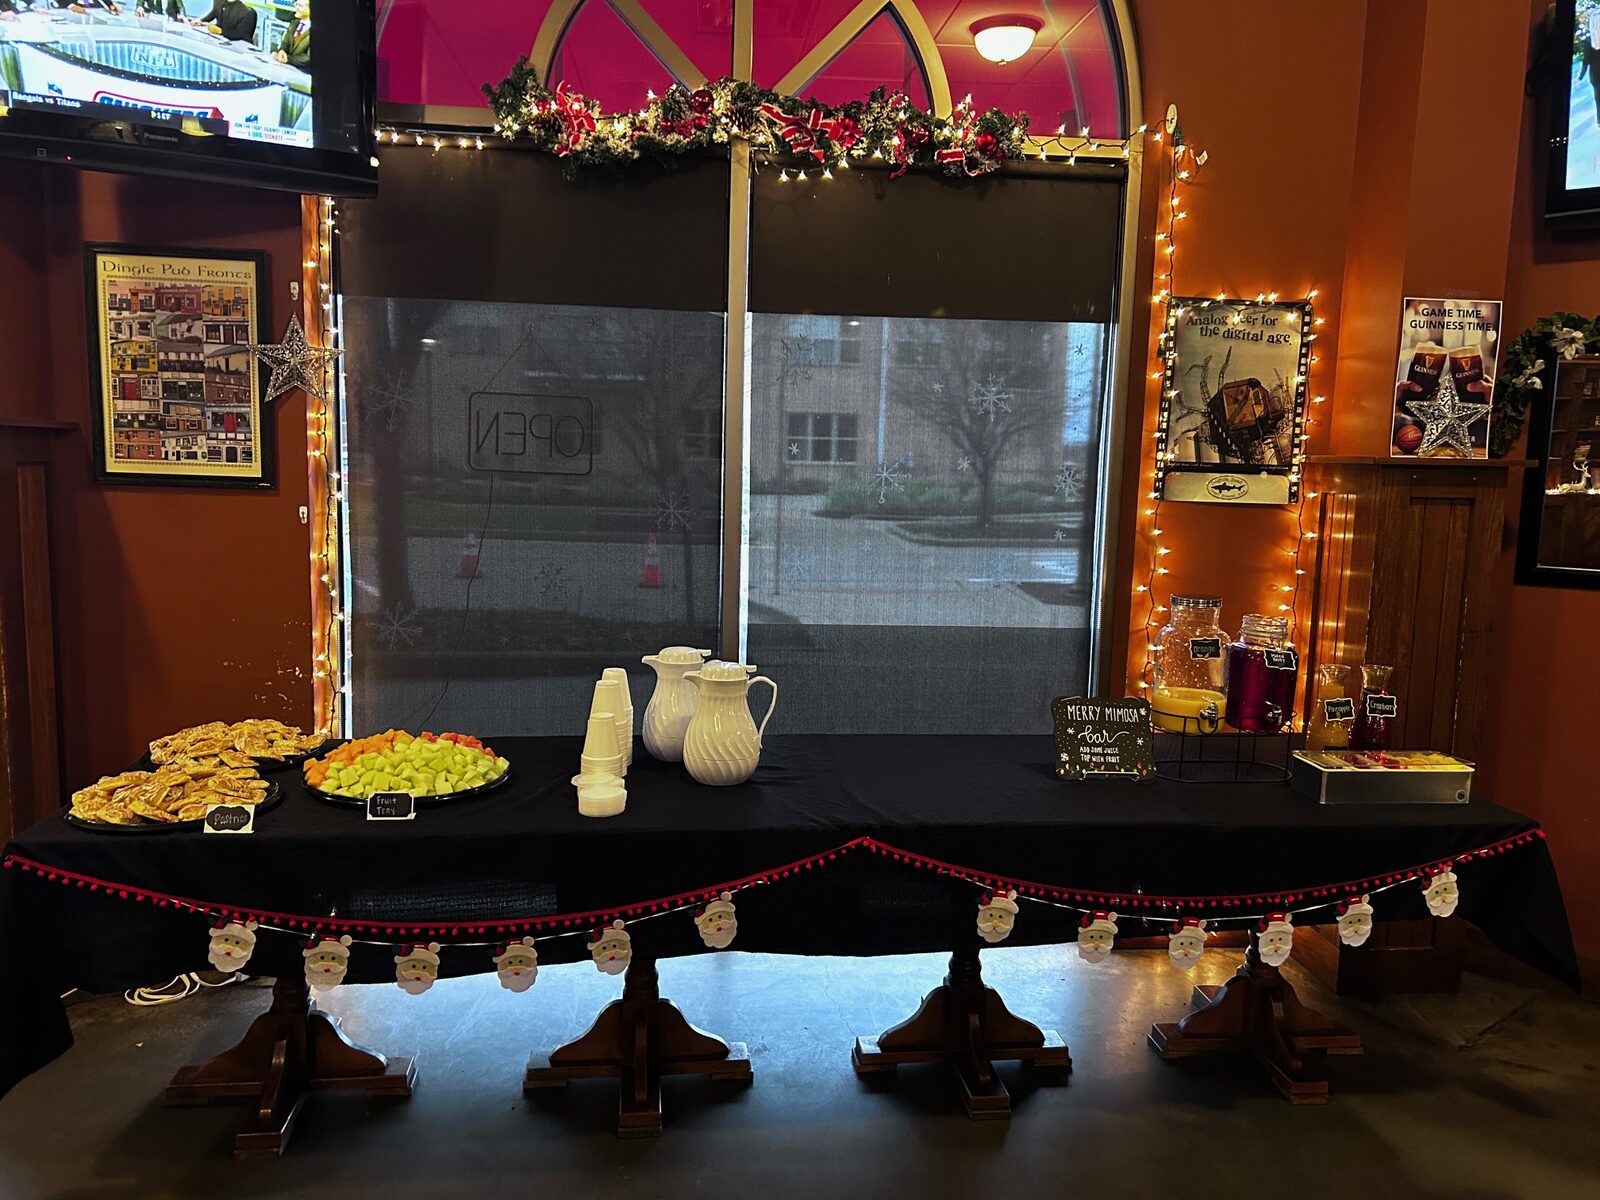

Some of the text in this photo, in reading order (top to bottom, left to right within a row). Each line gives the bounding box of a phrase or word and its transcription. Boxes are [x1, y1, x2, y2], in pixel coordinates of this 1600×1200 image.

[137, 52, 173, 67] NFL
[12, 91, 82, 108] Bengals vs Titans
[102, 260, 155, 276] Dingle
[162, 263, 191, 276] Pub
[1186, 313, 1279, 326] Analog eer for
[1421, 307, 1485, 319] GAME TIME.
[1409, 319, 1496, 332] GUINNESS TIME.
[1200, 326, 1293, 345] the digital age.
[1066, 704, 1140, 723] MERRY MIMOSA
[1077, 724, 1130, 744] bar
[1079, 746, 1091, 754] ADD
[1091, 746, 1103, 754] SOME
[1080, 753, 1120, 763] TOP WITH FRUIT
[376, 795, 397, 805] Fruit
[214, 813, 249, 826] Pastries
